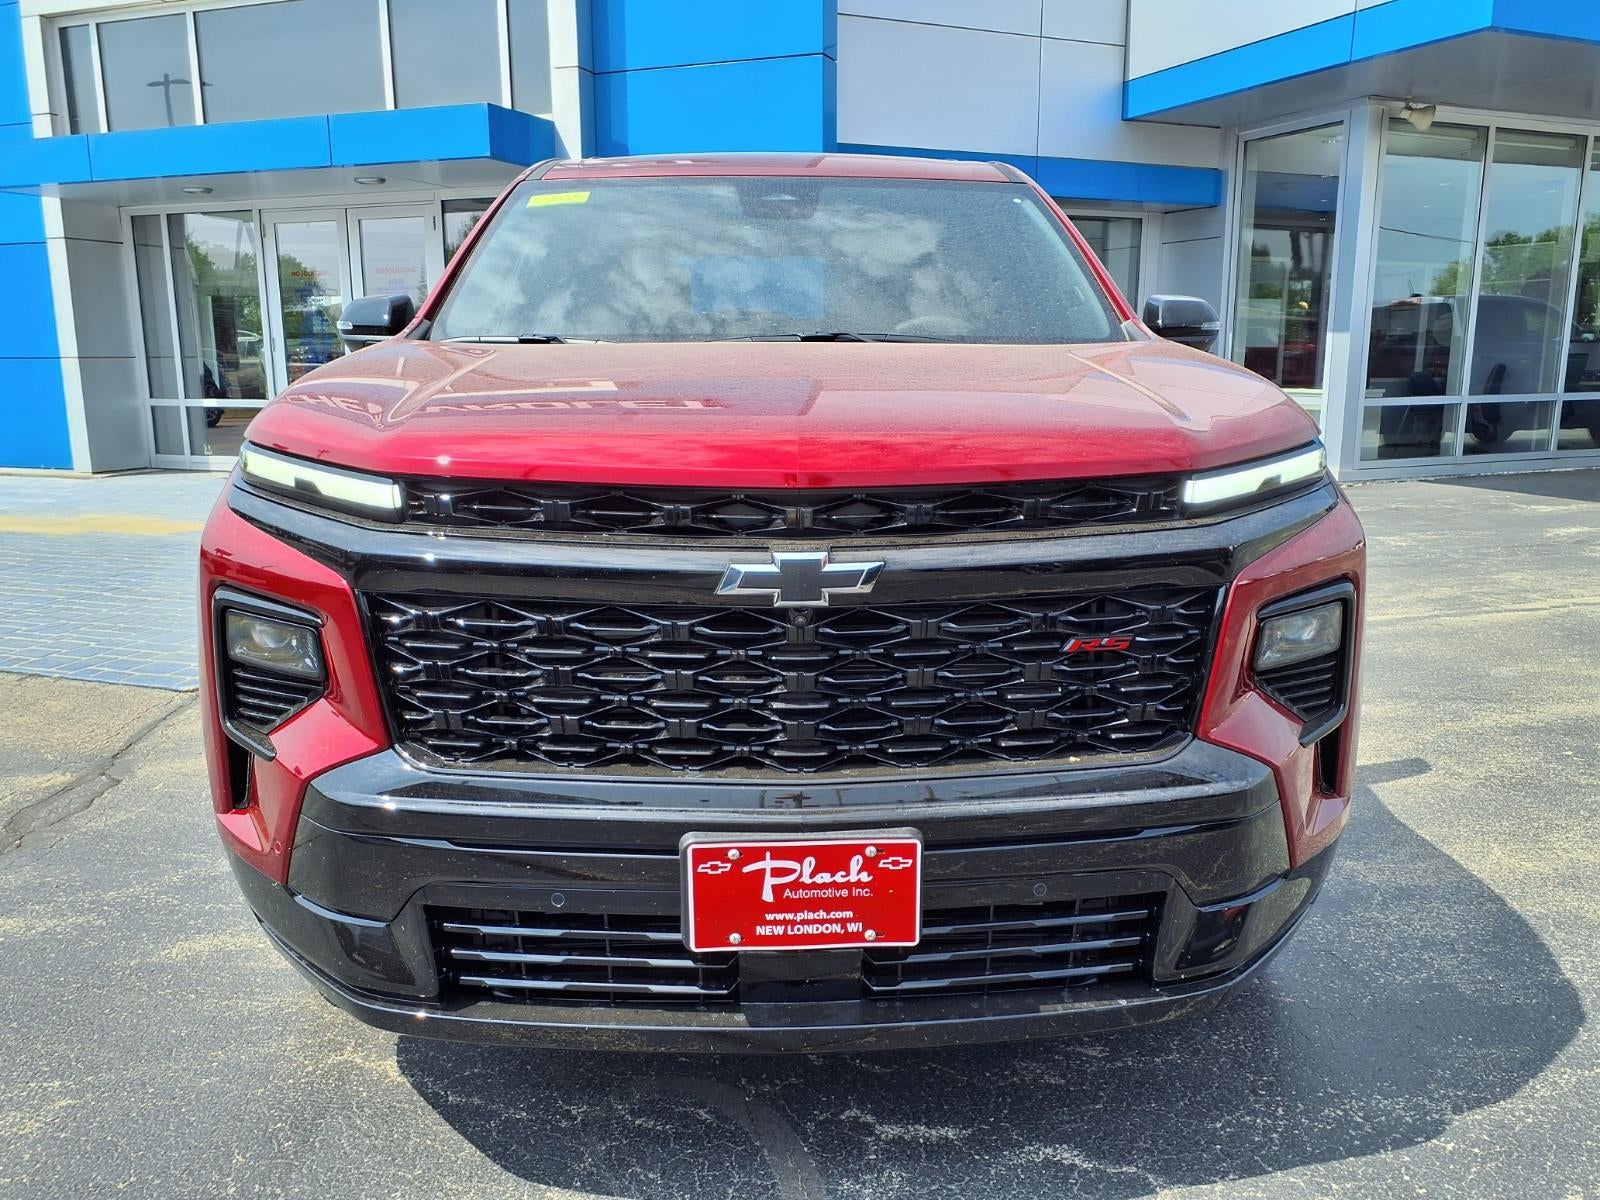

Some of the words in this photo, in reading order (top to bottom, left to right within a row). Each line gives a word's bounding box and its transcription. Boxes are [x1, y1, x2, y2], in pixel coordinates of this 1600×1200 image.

[1062, 635, 1133, 653] RS
[742, 851, 873, 903] Plach
[783, 888, 849, 899] Automotive
[852, 887, 874, 897] Inc.
[765, 909, 854, 922] www.plach.com
[756, 924, 785, 936] NEW
[787, 923, 845, 935] LONDON,
[847, 921, 863, 933] WI
